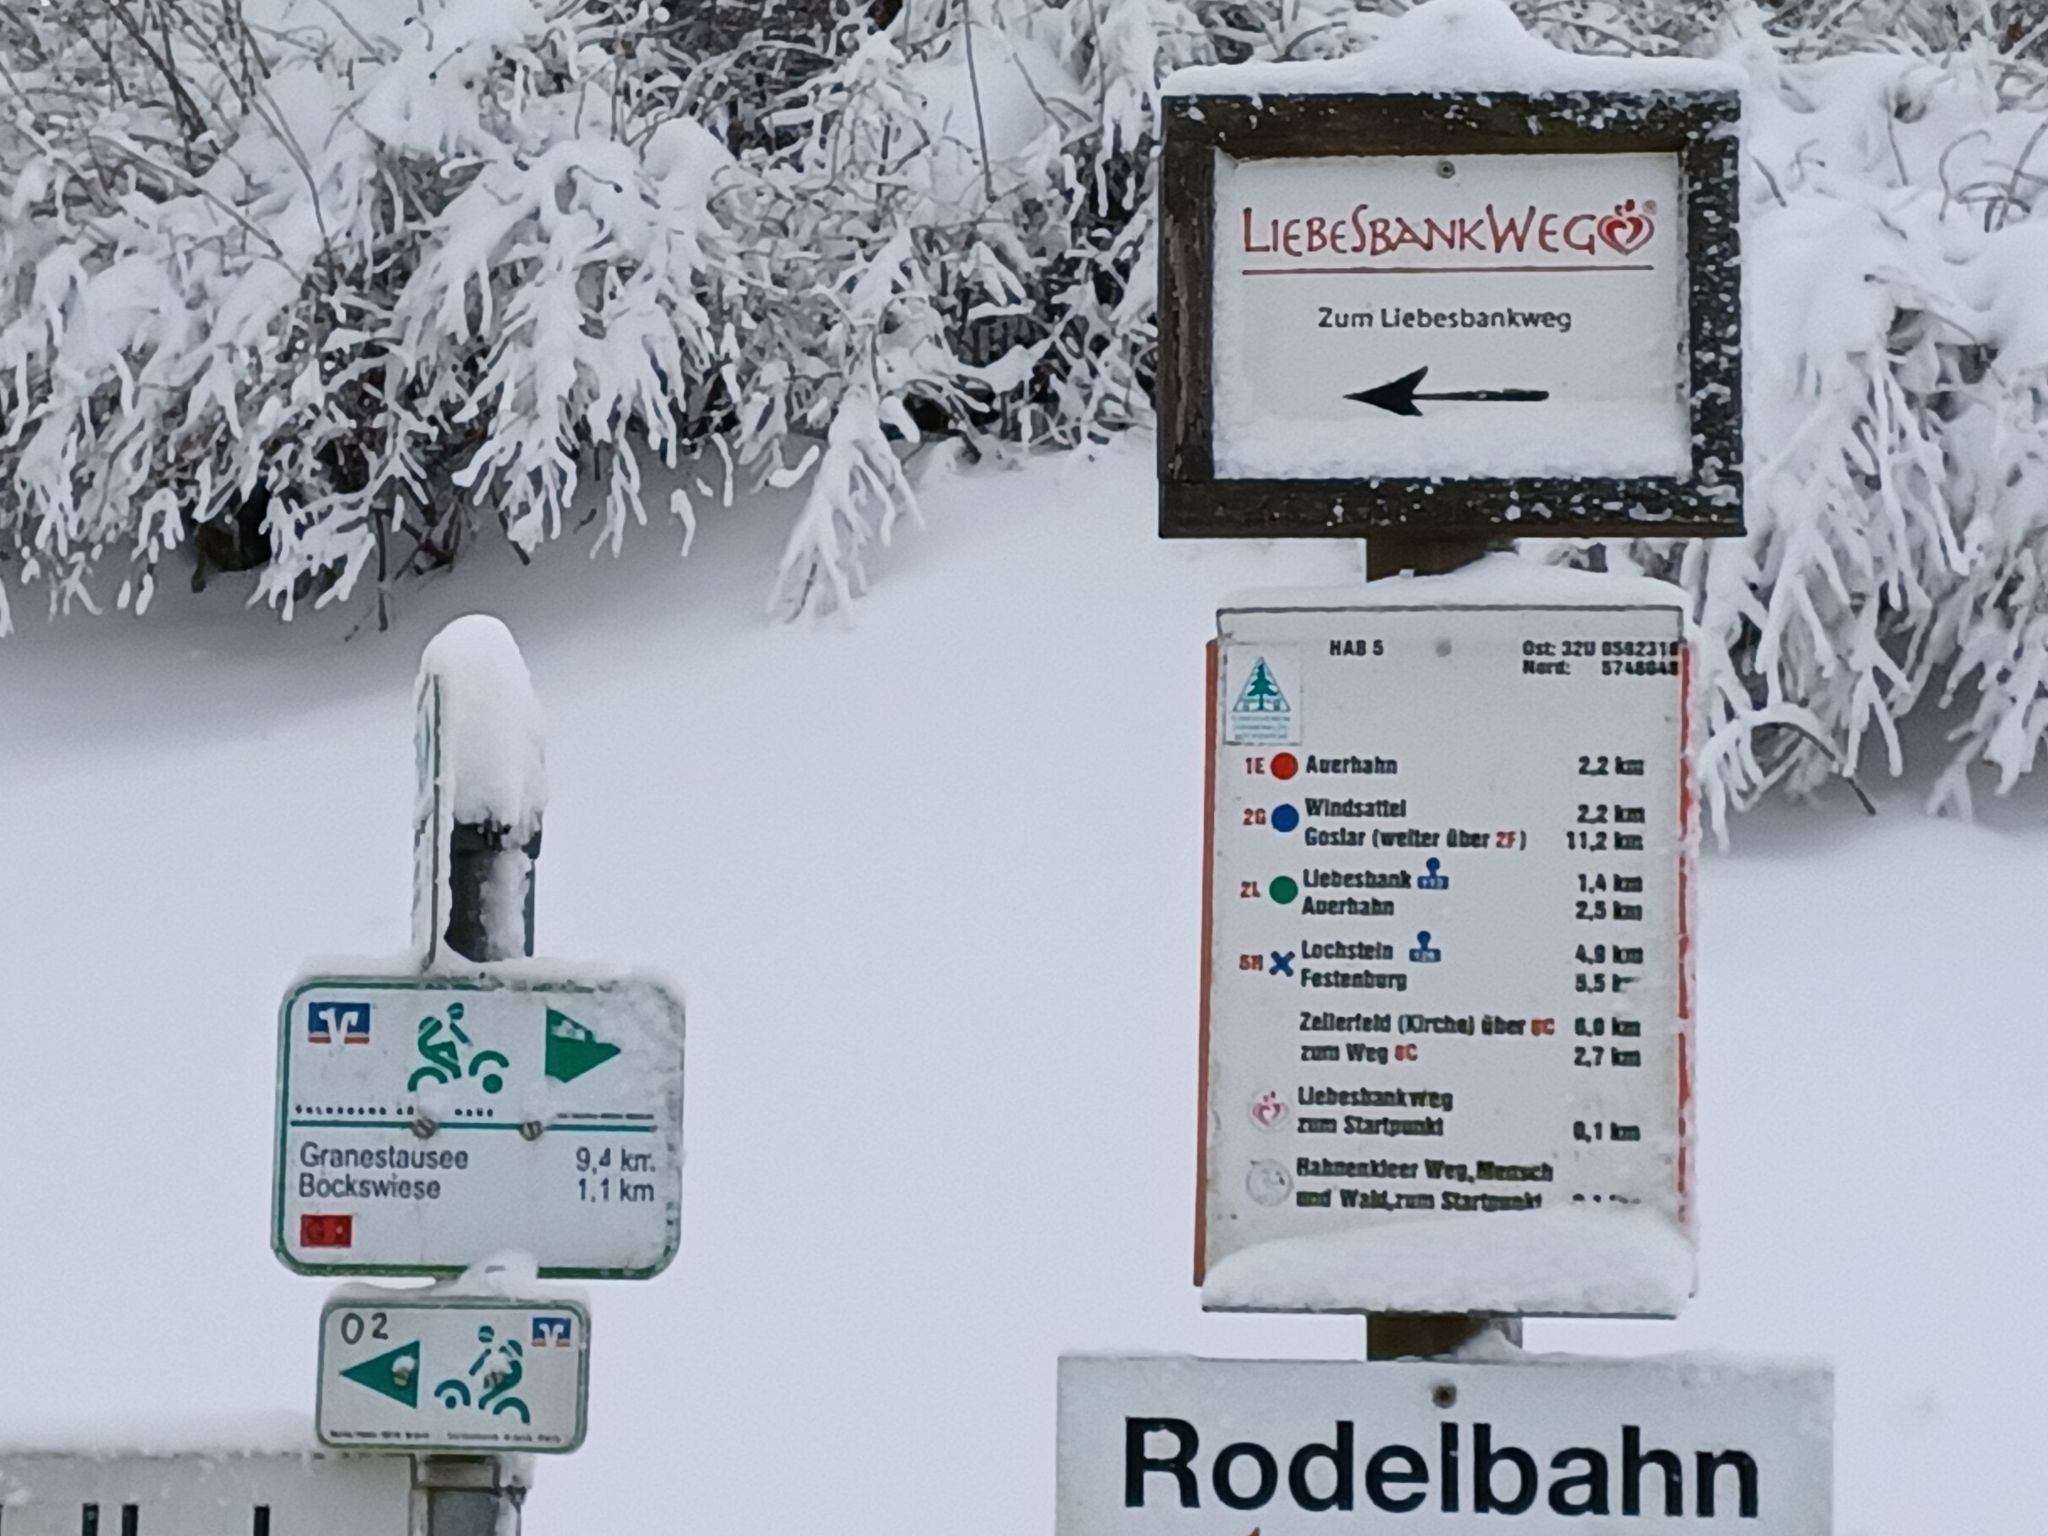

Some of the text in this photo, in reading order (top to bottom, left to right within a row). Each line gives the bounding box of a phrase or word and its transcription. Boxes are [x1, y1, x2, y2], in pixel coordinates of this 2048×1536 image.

[1318, 307, 1571, 333] Zum Liebesbankweg
[1330, 640, 1366, 656] HAB
[1246, 755, 1644, 776] 1E Auerhahn 2,2 km
[1305, 798, 1645, 824] Windsattel 2,2 km
[1305, 828, 1366, 846] Goslar
[1447, 829, 1490, 848] über
[1566, 831, 1607, 852] 11,2
[1614, 833, 1643, 850] km
[1303, 869, 1411, 889] Liebesbank
[1578, 874, 1606, 894] 1,4
[1614, 874, 1643, 892] km
[1302, 896, 1642, 921] Auerhahn 2,5 km
[1302, 940, 1393, 960] Lochstein
[1613, 945, 1643, 964] km
[1301, 968, 1407, 992] Festenburg
[1300, 1012, 1391, 1032] Zellerfeld
[1481, 1015, 1526, 1035] über
[1612, 1018, 1640, 1037] km
[1301, 1045, 1340, 1061] zum
[1346, 1043, 1388, 1065] Weg
[1574, 1046, 1603, 1067] 2,7
[1611, 1047, 1641, 1067] km
[1610, 1122, 1640, 1141] km
[300, 1141, 468, 1169] Granestausee
[576, 1147, 611, 1174] 9,4
[299, 1172, 440, 1200] Bockswiese
[620, 1178, 654, 1201] km
[1125, 1417, 1758, 1518] Rodelbahn
